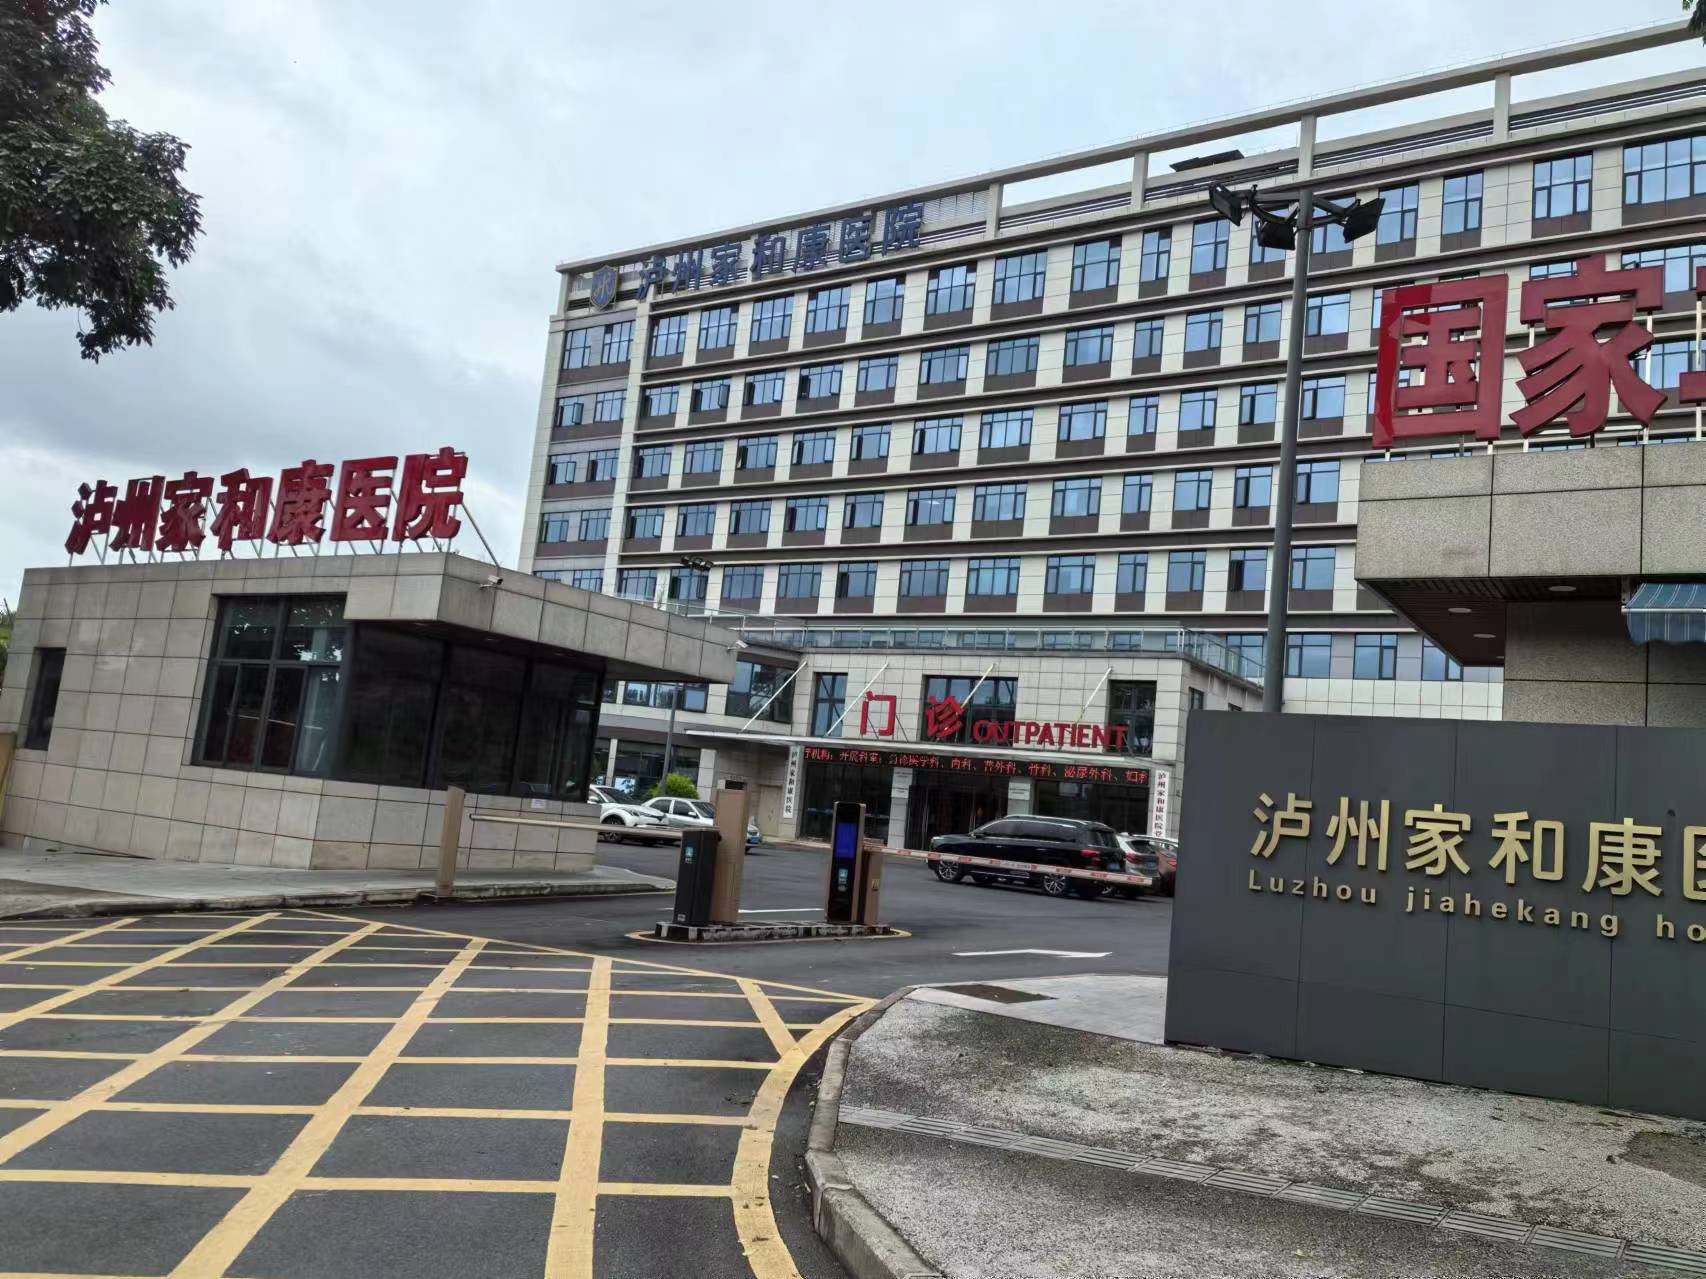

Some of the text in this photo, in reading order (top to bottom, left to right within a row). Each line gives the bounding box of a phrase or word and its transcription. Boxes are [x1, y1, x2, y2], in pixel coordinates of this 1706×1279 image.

[637, 202, 924, 299] 泸州家和康医院
[64, 447, 468, 555] 泸州家和康医院
[859, 691, 964, 738] 门诊
[973, 719, 1128, 750] OUTPATIENT
[1249, 869, 1376, 904] Luzhou
[1405, 887, 1619, 937] jiahekang
